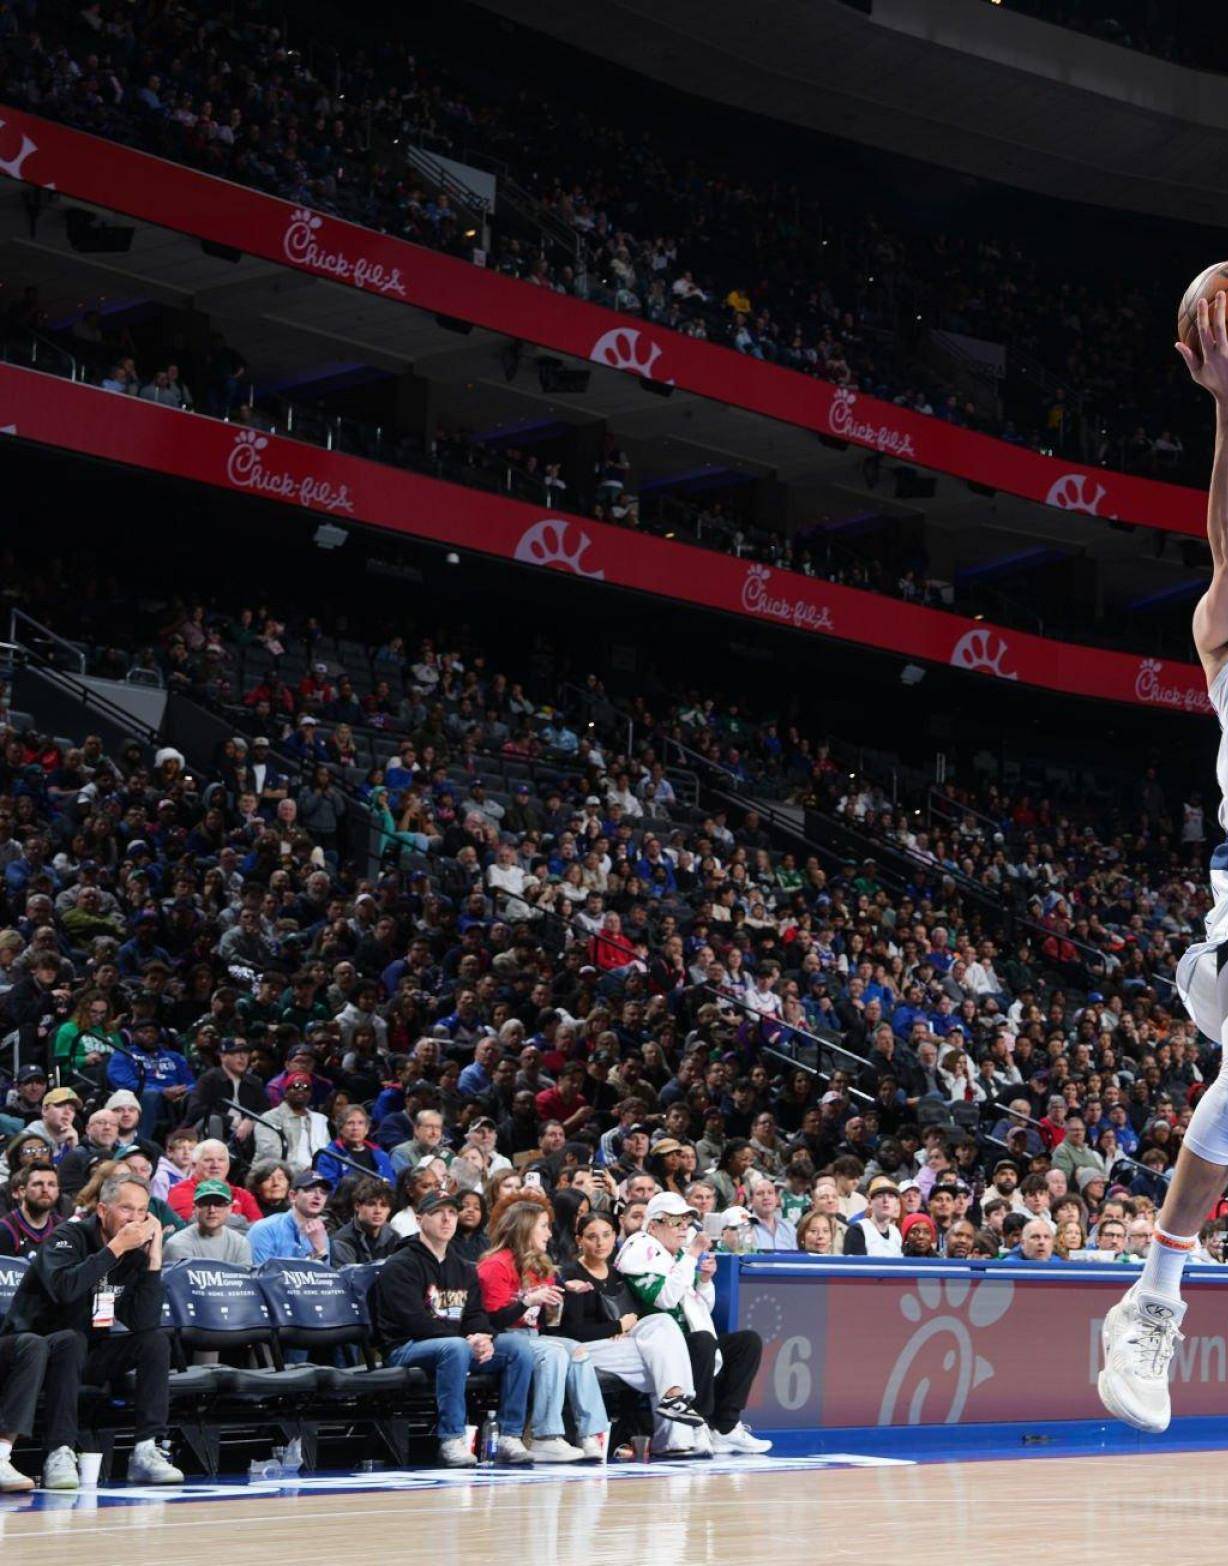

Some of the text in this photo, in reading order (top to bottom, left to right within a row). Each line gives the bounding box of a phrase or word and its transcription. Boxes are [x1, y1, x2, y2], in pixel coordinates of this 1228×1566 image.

[284, 220, 407, 296] Chick-fil-A
[829, 399, 915, 457] Chick-fil-A
[227, 442, 355, 513] Chick-fil-A
[741, 575, 835, 630] Chick-fil-A
[1135, 668, 1210, 712] Chick-fil-
[188, 1270, 223, 1289] NJM
[223, 1279, 243, 1288] Group
[282, 1270, 315, 1289] NJM
[314, 1278, 333, 1287] Group
